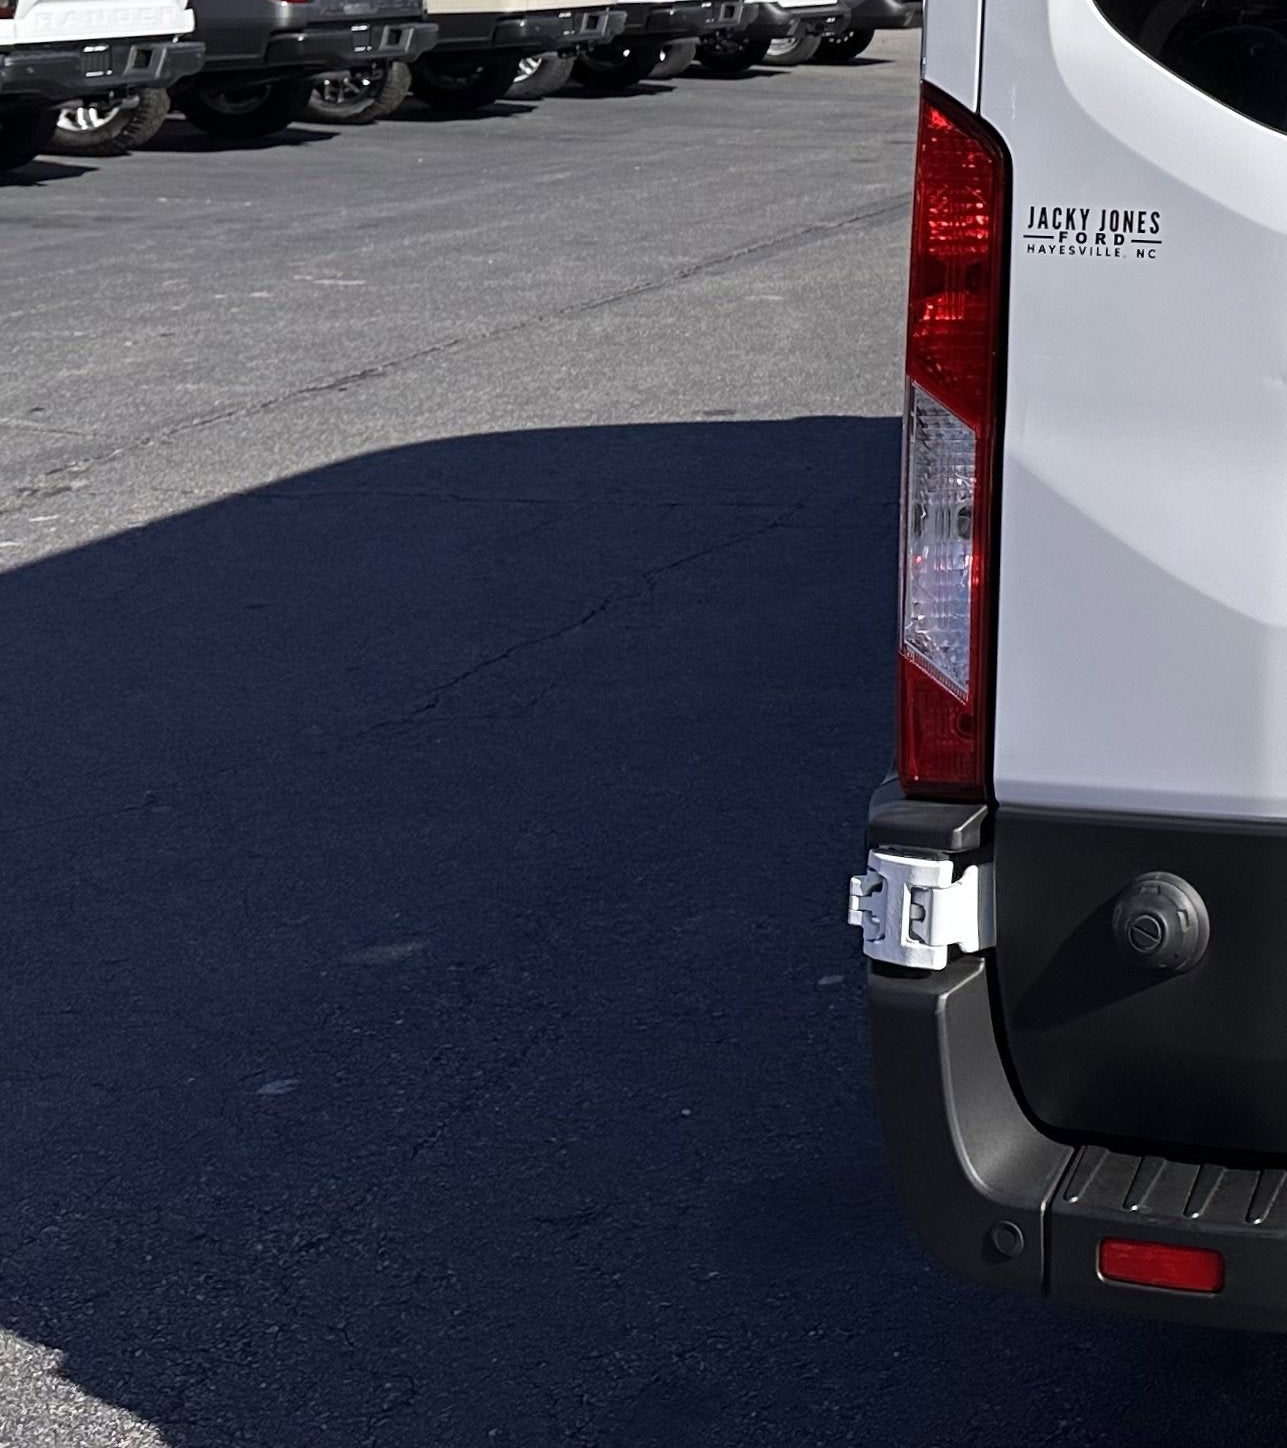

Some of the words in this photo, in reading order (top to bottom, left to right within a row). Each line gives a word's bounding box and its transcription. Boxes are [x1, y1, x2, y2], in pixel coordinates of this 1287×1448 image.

[1027, 206, 1091, 231] JACKY
[1098, 208, 1161, 235] JONES
[1058, 231, 1125, 246] FORD
[1136, 248, 1157, 259] NC
